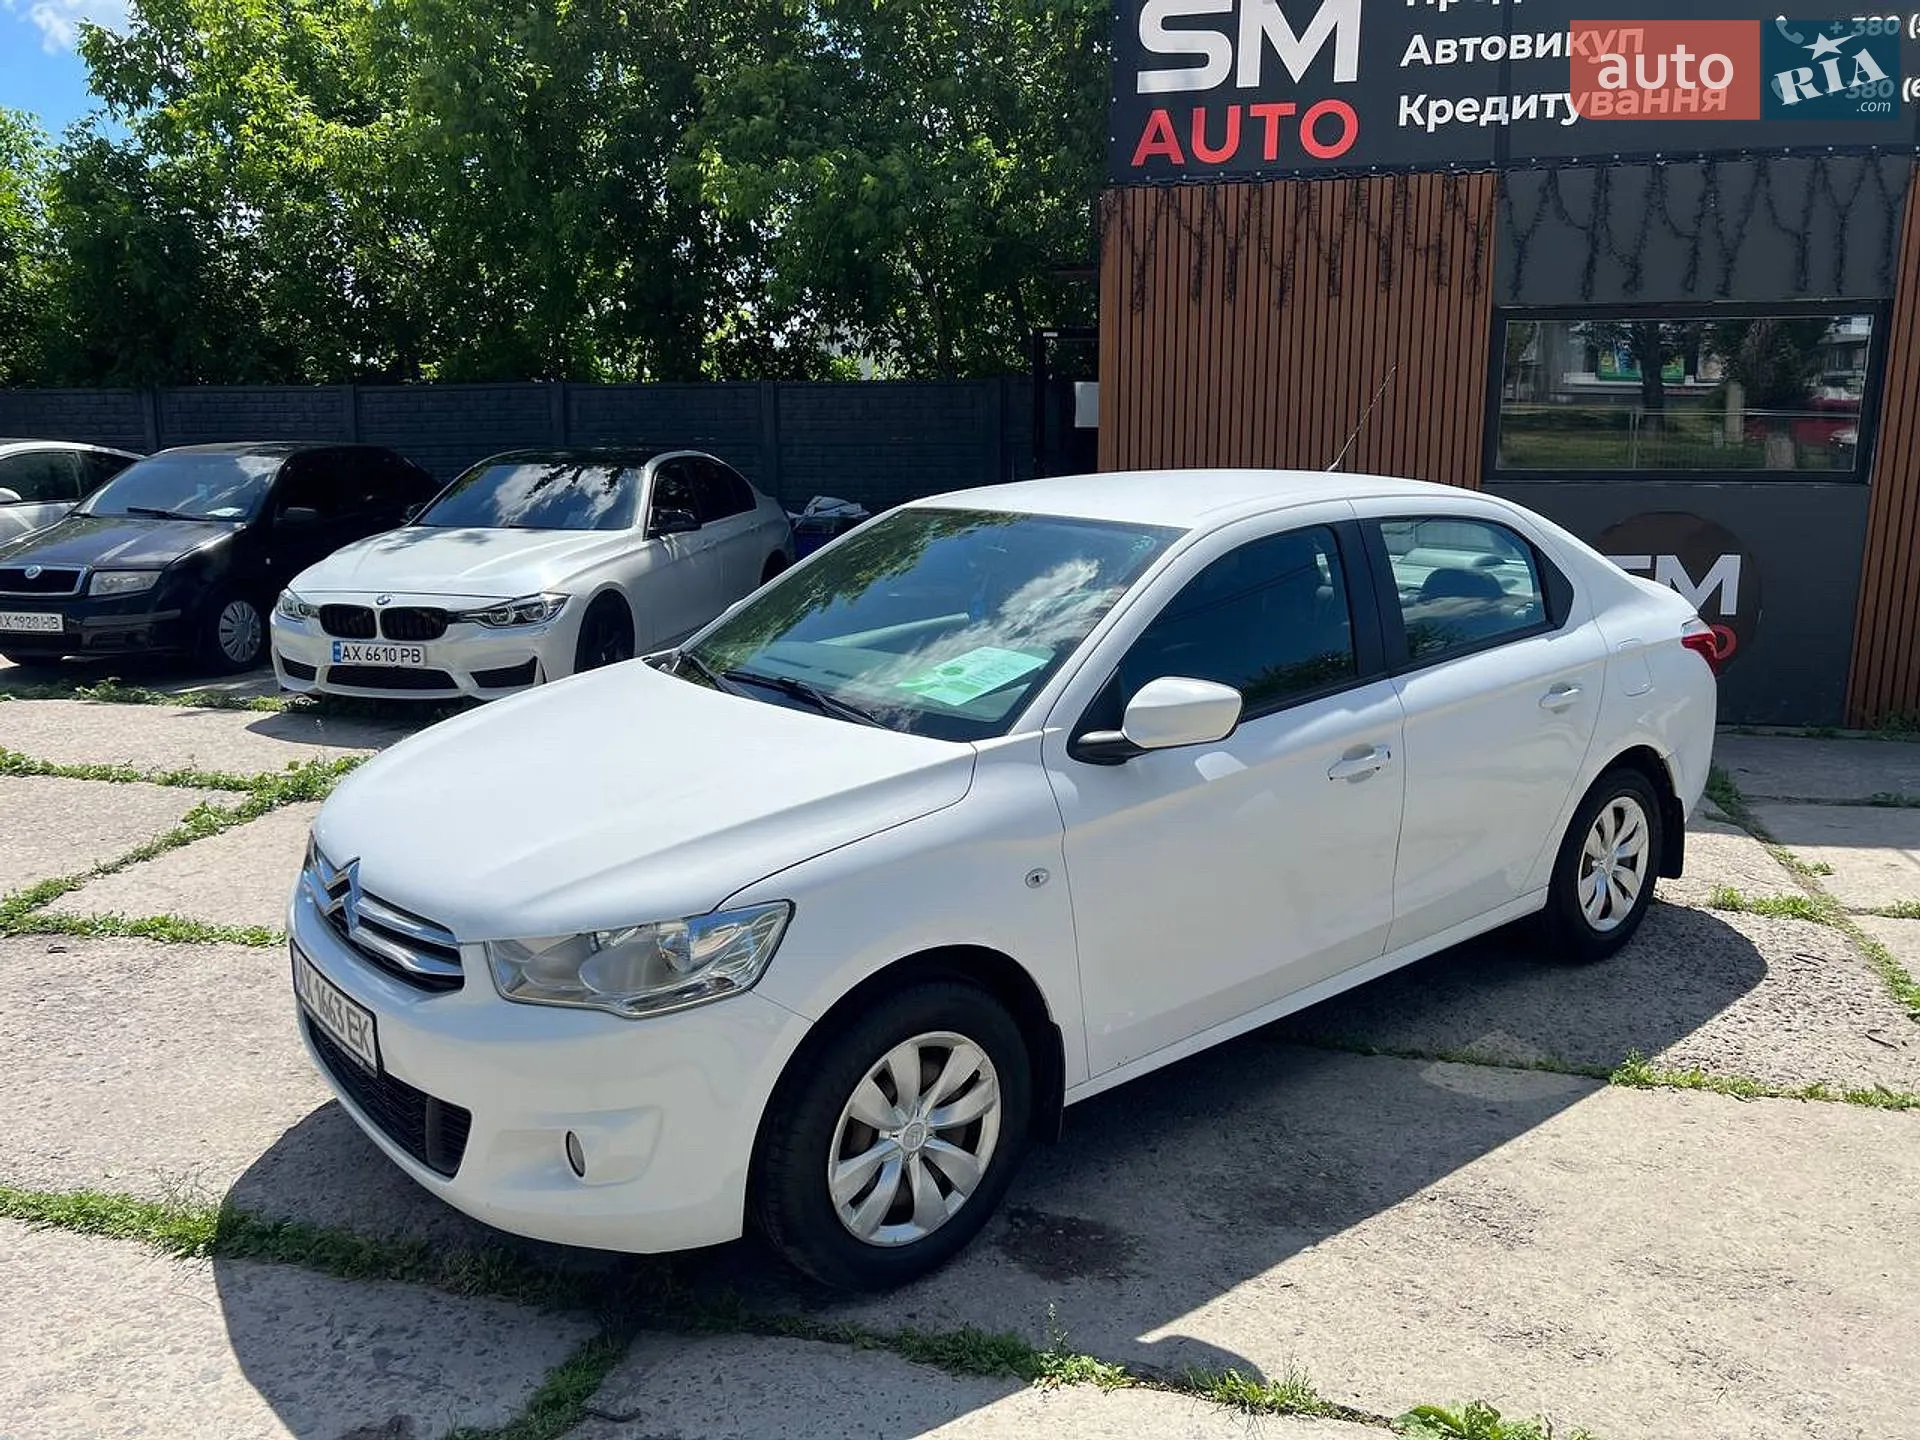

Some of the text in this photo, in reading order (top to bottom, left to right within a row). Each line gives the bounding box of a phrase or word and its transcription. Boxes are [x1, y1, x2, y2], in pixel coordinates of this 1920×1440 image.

[1137, 0, 1362, 94] SM
[1400, 28, 1644, 67] Автовикуп
[1398, 87, 1727, 132] Кредитування
[1131, 99, 1359, 167] AUTO
[342, 645, 421, 663] AX 6610 PB
